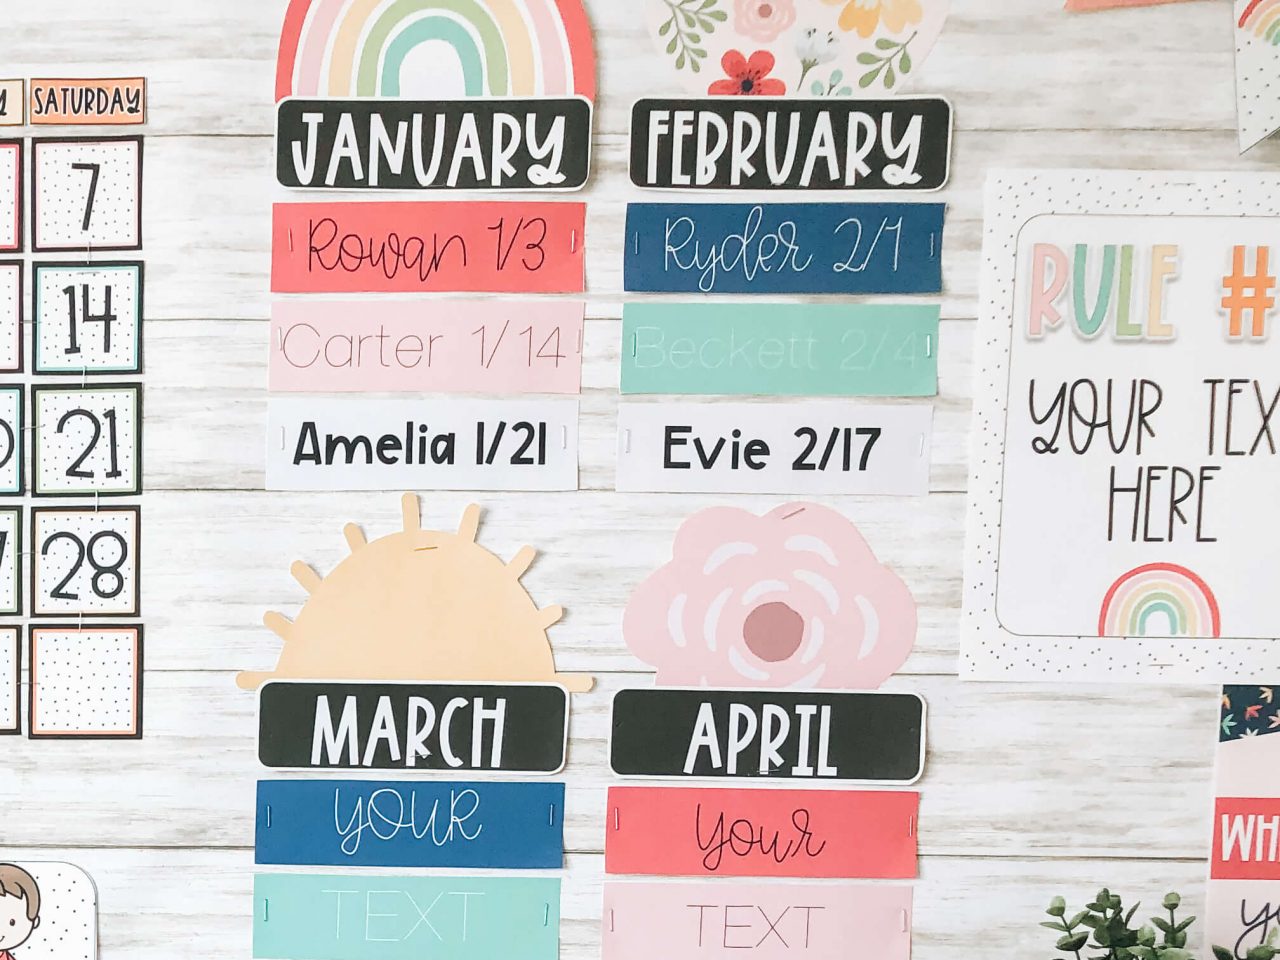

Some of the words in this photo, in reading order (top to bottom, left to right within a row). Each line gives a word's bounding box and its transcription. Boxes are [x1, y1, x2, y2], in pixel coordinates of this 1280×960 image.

[33, 86, 141, 116] SATURDAY
[291, 112, 566, 188] JANUARY
[648, 109, 923, 187] FEBRUARY
[72, 163, 99, 230] 7
[307, 217, 468, 281] Rowan
[487, 216, 547, 272] 1/3
[663, 206, 814, 292] Ryder
[833, 217, 903, 273] 2/1
[63, 285, 116, 354] 14
[1027, 243, 1181, 340] RULE
[282, 322, 443, 368] Carter
[472, 321, 566, 368] 1/14
[635, 326, 819, 370] Beckett
[839, 326, 920, 371] 2/4
[57, 409, 121, 478] 21
[293, 421, 455, 466] Amelia
[476, 421, 547, 466] 1/21
[663, 426, 770, 471] Evie
[792, 427, 882, 472] 2/17
[1029, 378, 1163, 456] YOUR
[1107, 465, 1222, 542] HERE
[42, 531, 127, 599] 28
[310, 695, 507, 769] MARCH
[683, 702, 838, 777] APRIL
[322, 890, 486, 942] TEXT
[687, 904, 825, 949] TEXT
